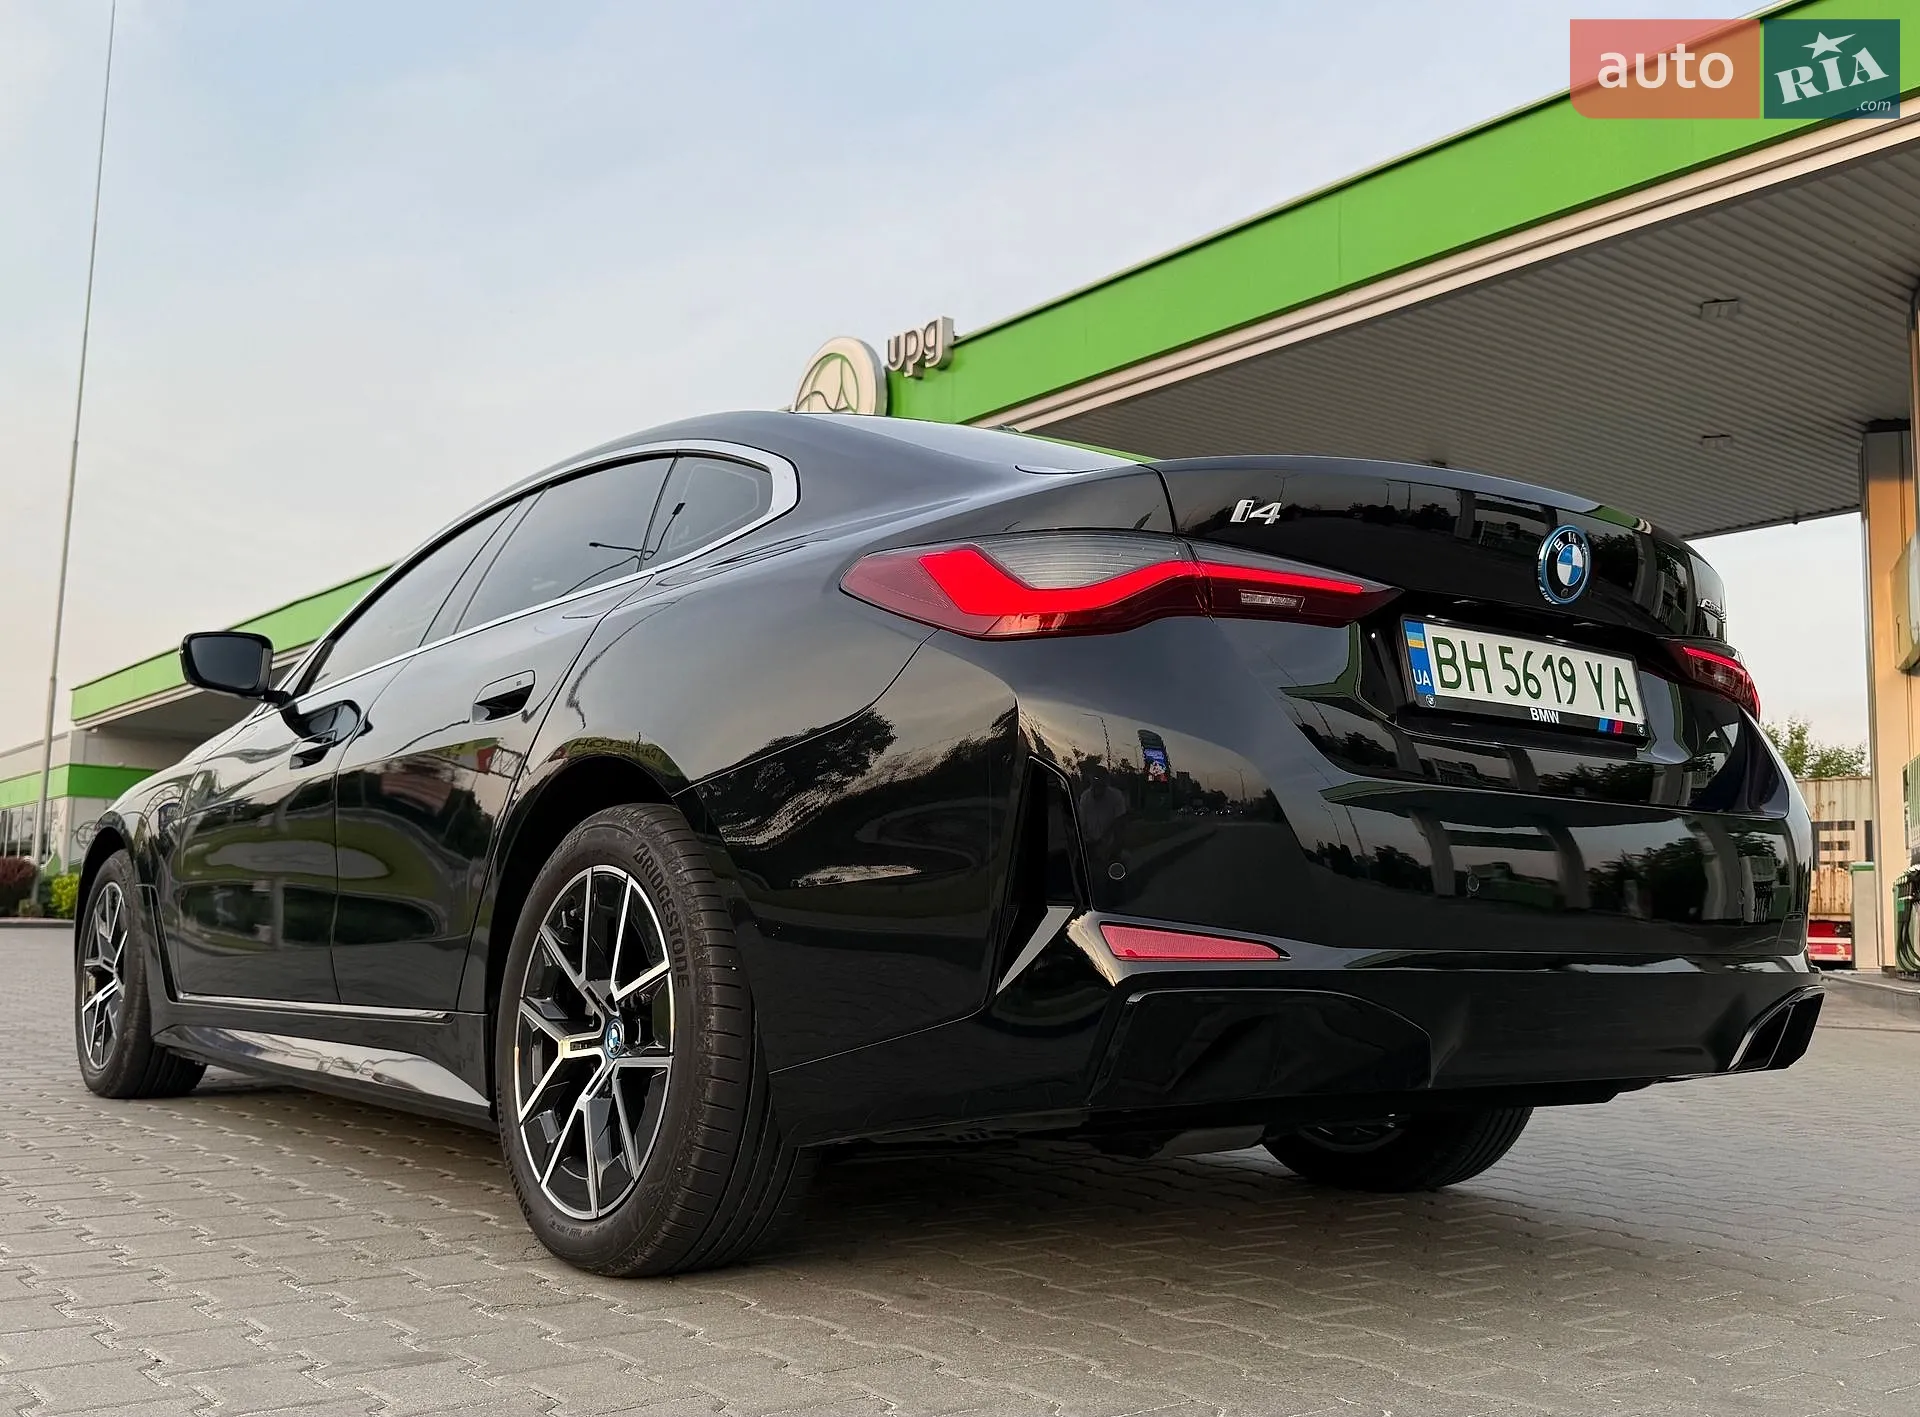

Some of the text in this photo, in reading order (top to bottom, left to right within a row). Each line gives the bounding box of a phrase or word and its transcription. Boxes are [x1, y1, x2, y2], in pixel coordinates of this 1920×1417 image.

[888, 316, 953, 379] upg
[1229, 499, 1282, 525] i4
[1412, 667, 1432, 687] UA
[1431, 636, 1636, 717] BH 5619 YA
[1530, 707, 1560, 724] BMW
[632, 842, 690, 989] BRIDGESTONE
